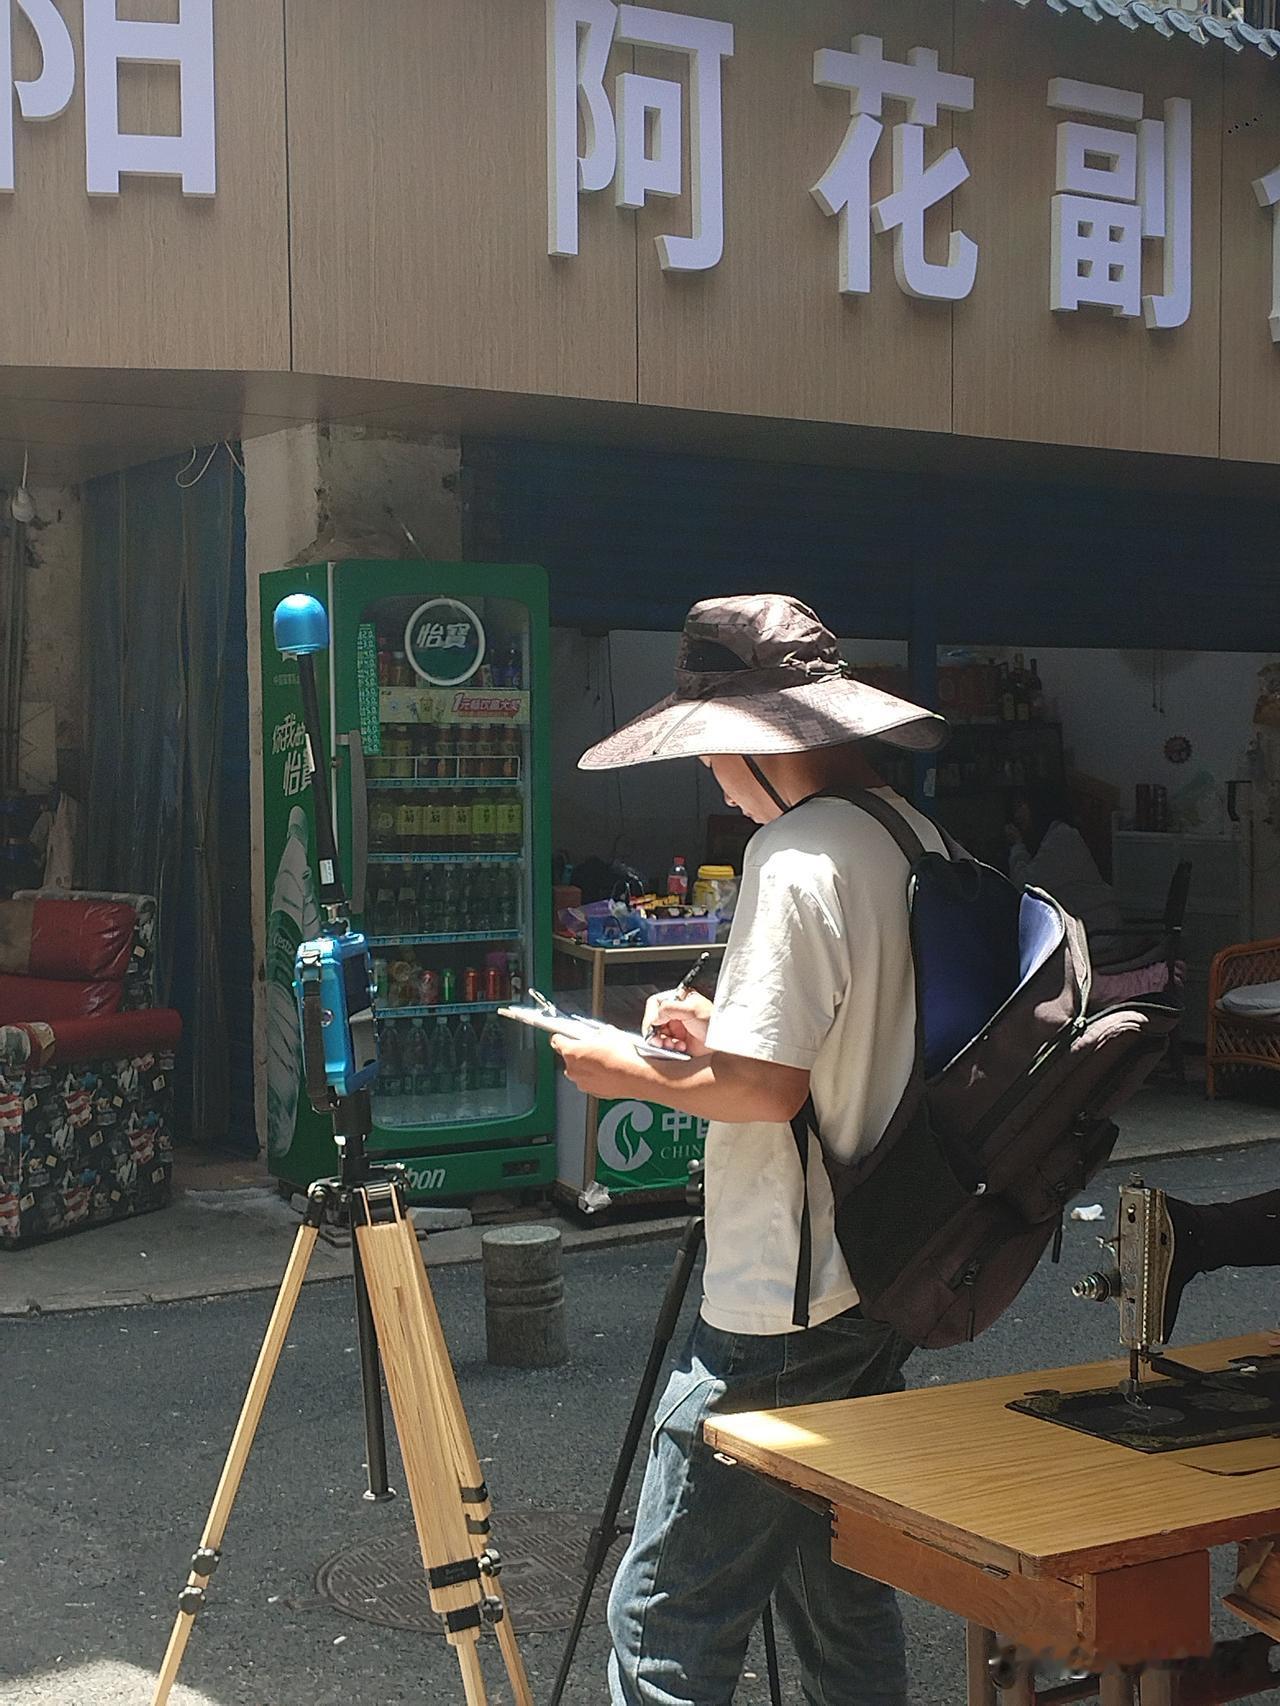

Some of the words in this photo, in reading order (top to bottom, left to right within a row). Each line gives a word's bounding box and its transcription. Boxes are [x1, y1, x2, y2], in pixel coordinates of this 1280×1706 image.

[0, 0, 216, 197] 阳
[547, 0, 1280, 342] 阿花副
